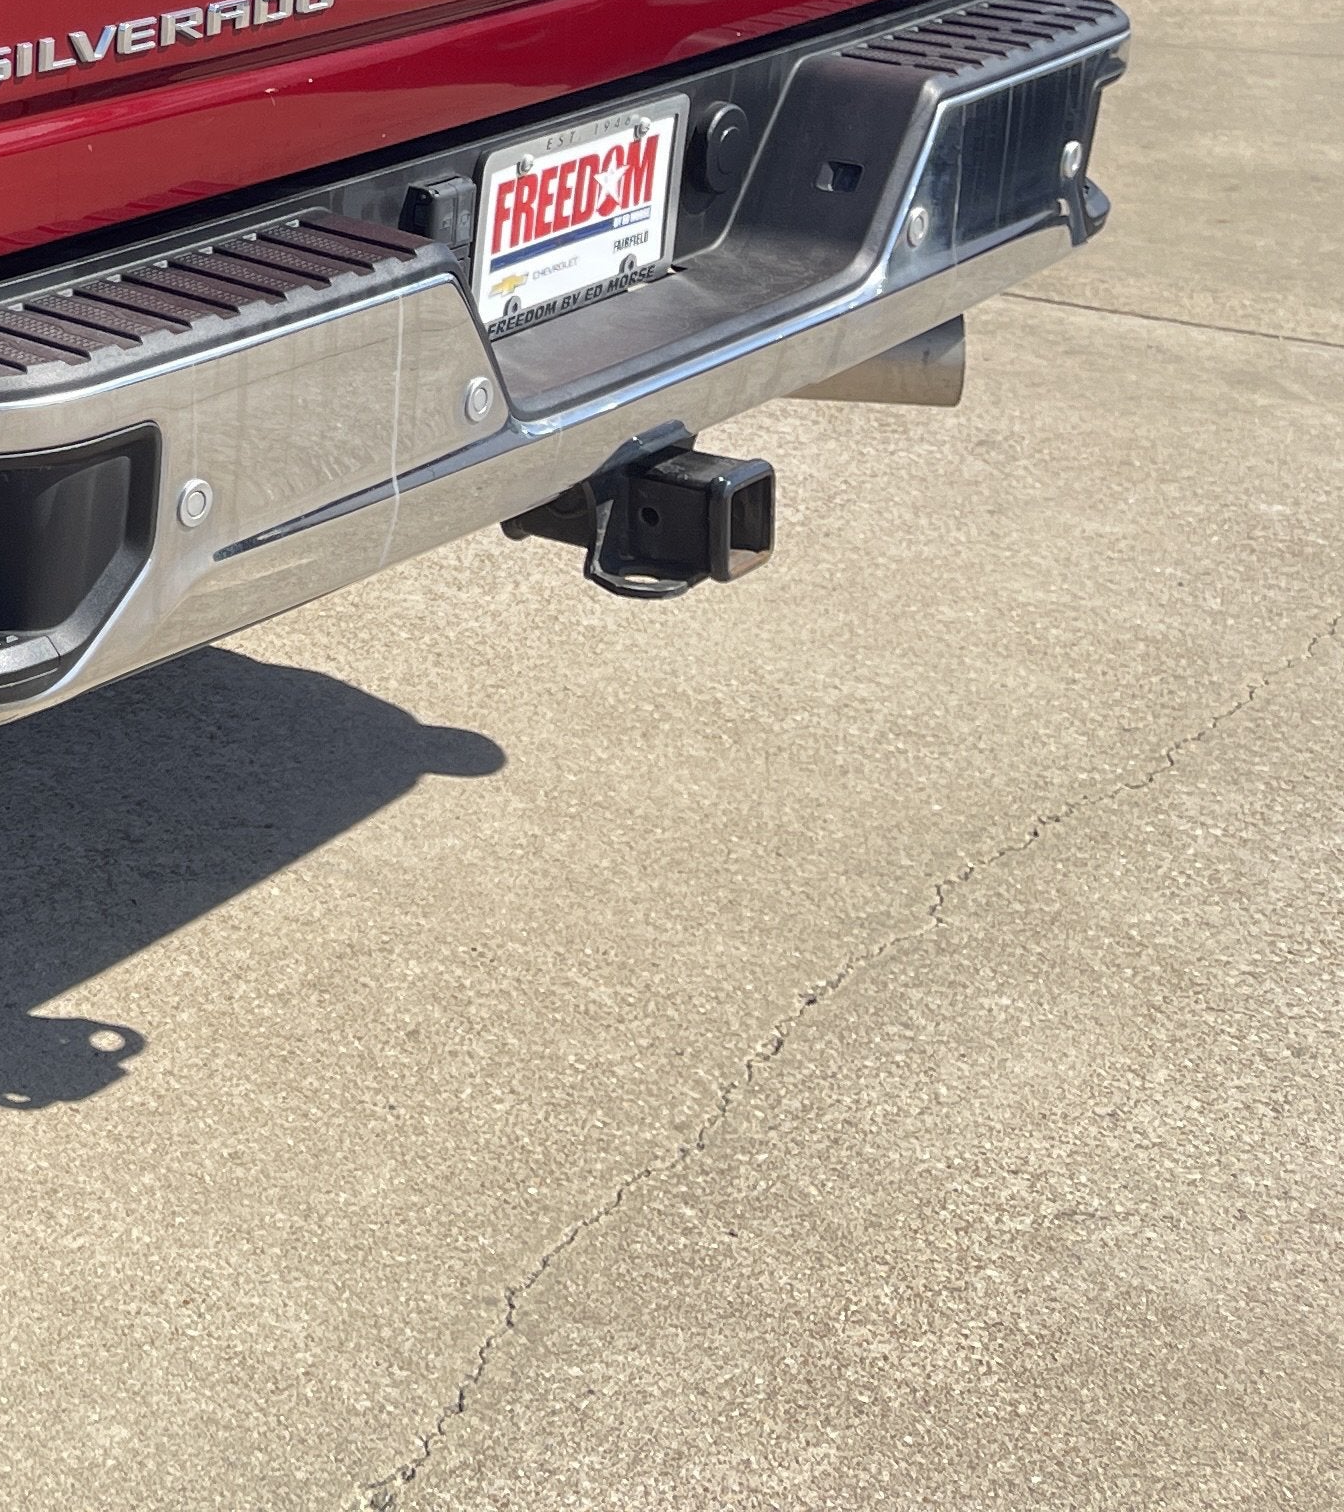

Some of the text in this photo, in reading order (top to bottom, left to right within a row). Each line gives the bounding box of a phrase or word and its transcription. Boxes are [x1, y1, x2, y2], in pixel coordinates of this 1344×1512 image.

[613, 230, 649, 253] FAIRFIELD
[532, 255, 579, 281] CHEVROLET
[487, 264, 656, 337] FREEDOM BY ED MORSE
